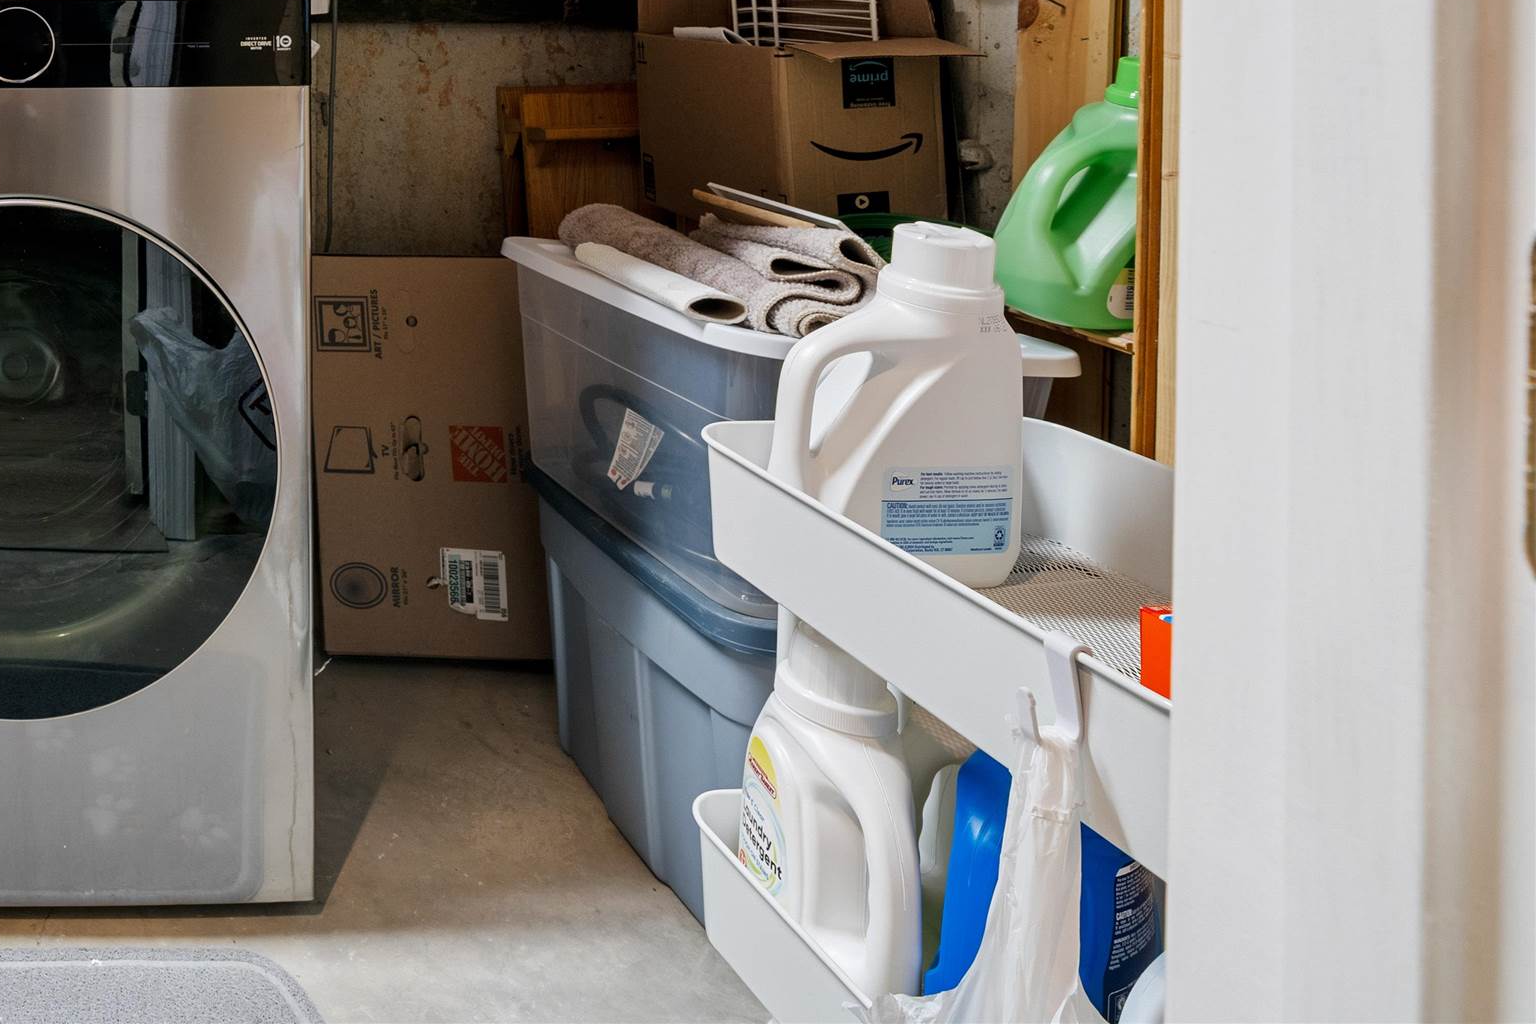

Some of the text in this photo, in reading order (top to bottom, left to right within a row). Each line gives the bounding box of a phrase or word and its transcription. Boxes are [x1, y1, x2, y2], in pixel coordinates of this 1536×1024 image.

[848, 70, 889, 85] prime
[892, 476, 914, 486] Purex
[390, 566, 401, 608] MIRROR
